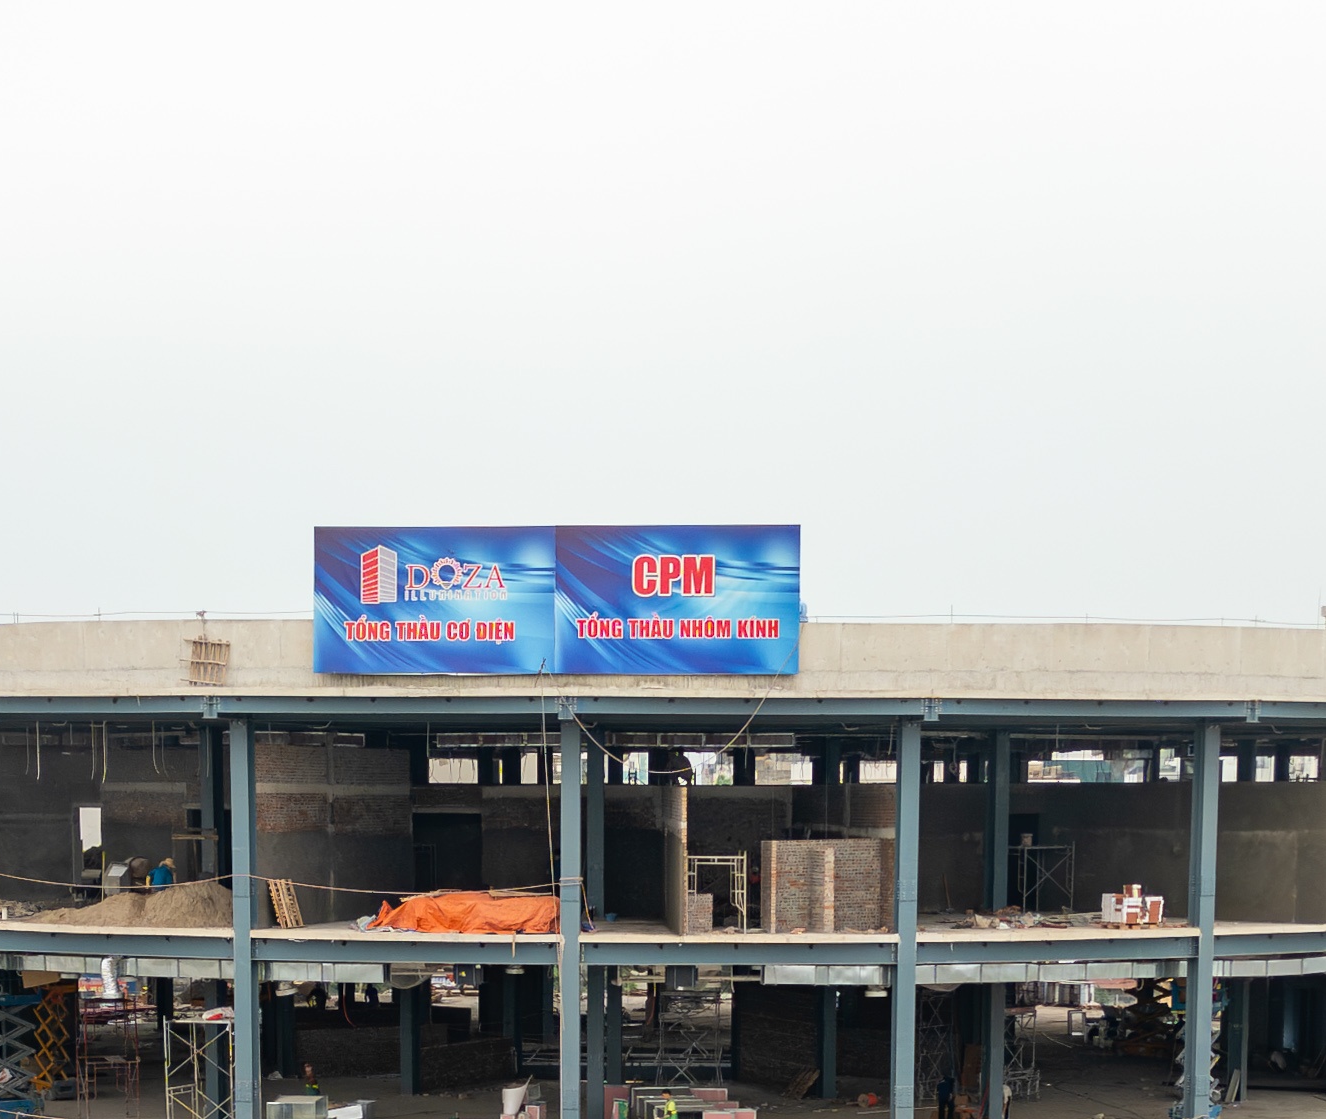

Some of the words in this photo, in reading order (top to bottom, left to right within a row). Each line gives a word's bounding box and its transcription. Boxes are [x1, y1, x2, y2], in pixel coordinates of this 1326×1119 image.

[632, 554, 716, 597] CPM
[404, 590, 508, 601] ILLUMINATION
[344, 615, 391, 641] TỔNG
[396, 615, 441, 641] THẦU
[446, 618, 471, 641] CƠ
[475, 618, 515, 644] ĐIỆN
[576, 612, 623, 639] TỔNG
[628, 612, 674, 639] THẦU
[680, 616, 731, 638] NHÔM
[737, 616, 779, 638] KÍNH
